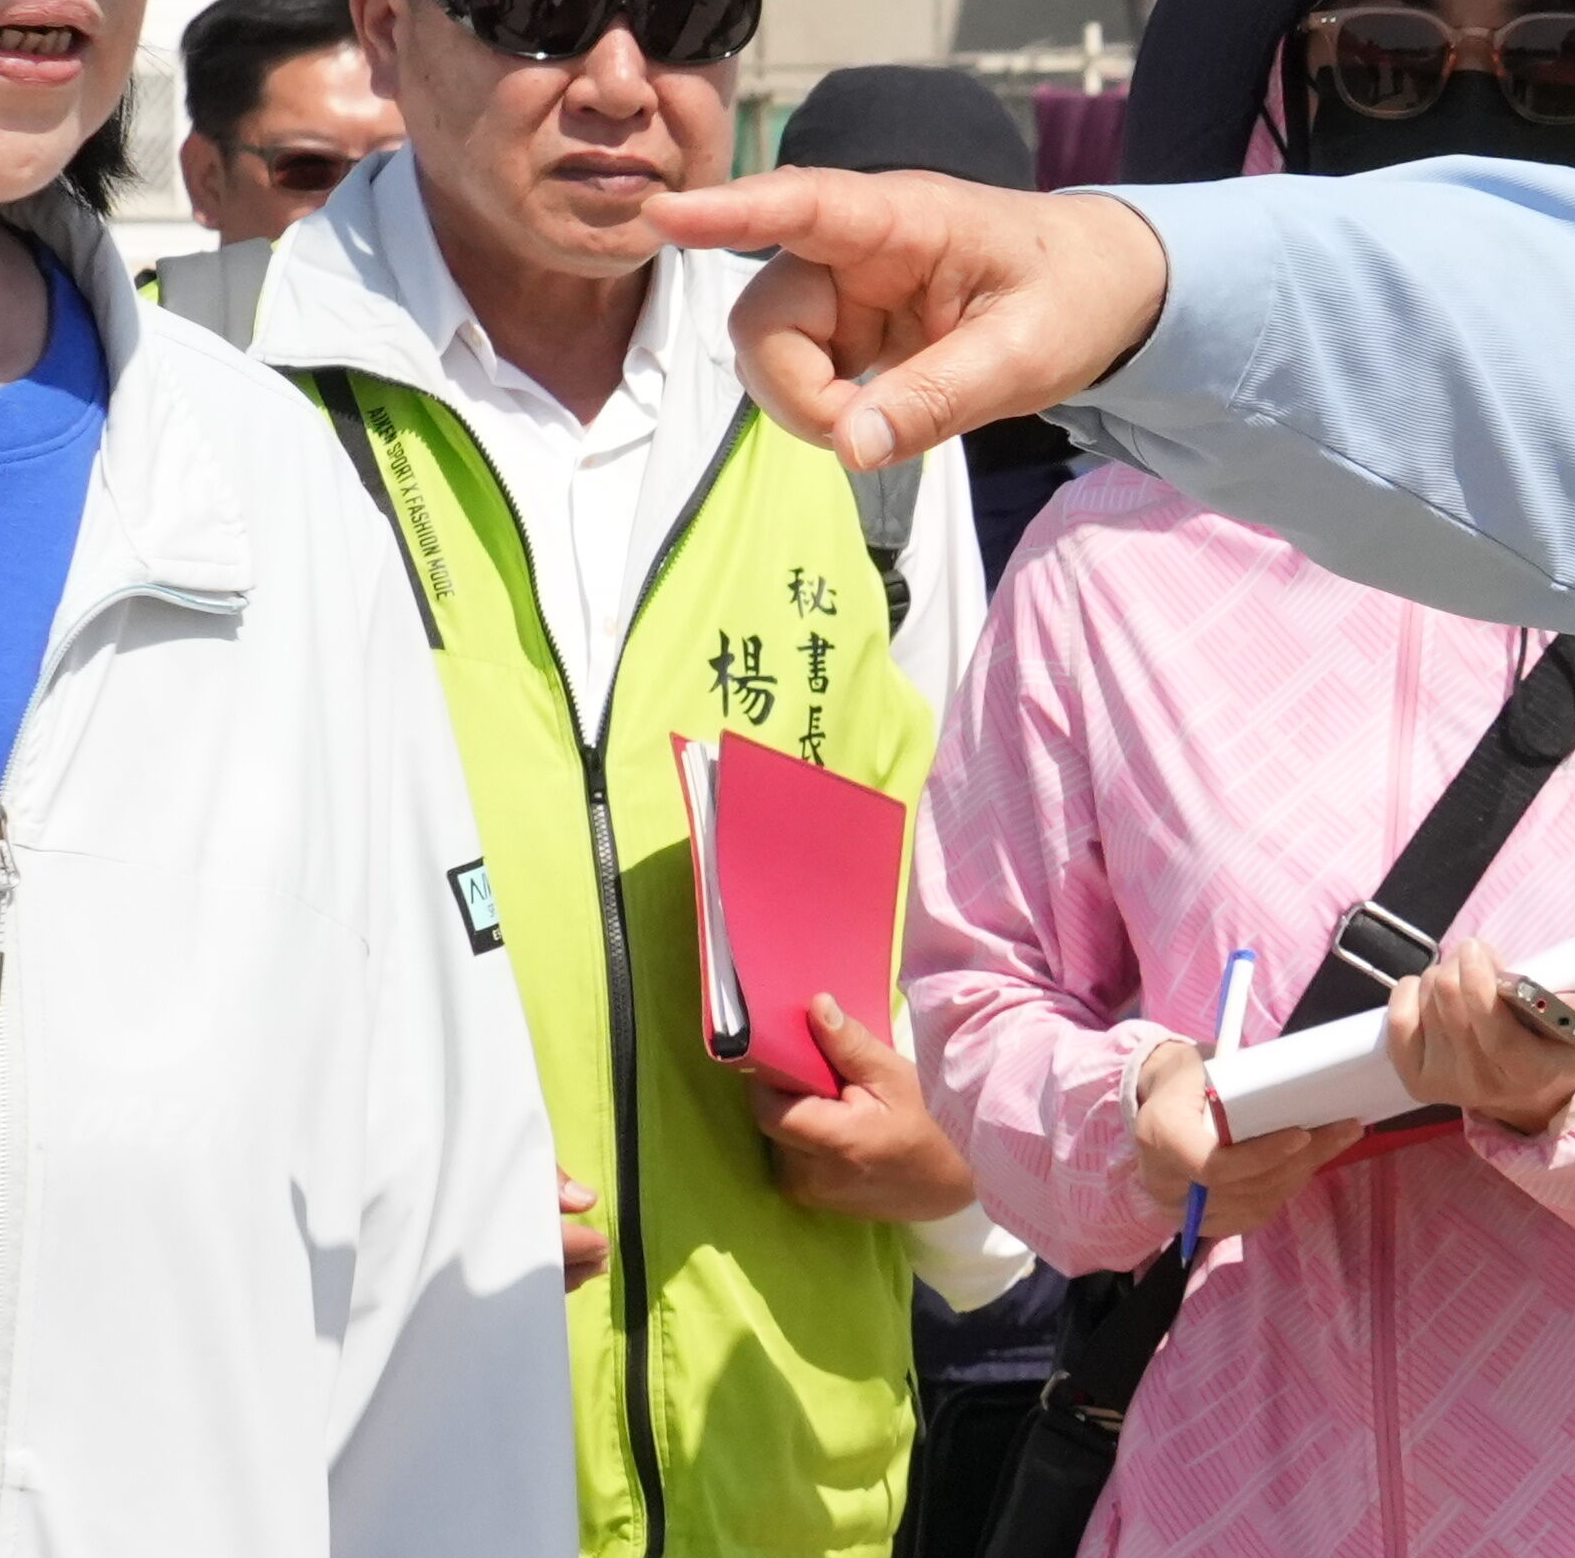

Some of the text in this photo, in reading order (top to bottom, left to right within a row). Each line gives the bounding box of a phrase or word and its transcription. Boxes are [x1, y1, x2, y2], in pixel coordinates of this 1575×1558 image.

[367, 406, 455, 602] AIKEN SPORT X FASHION MODE
[708, 628, 778, 726] 楊
[787, 566, 838, 768] 秘書長
